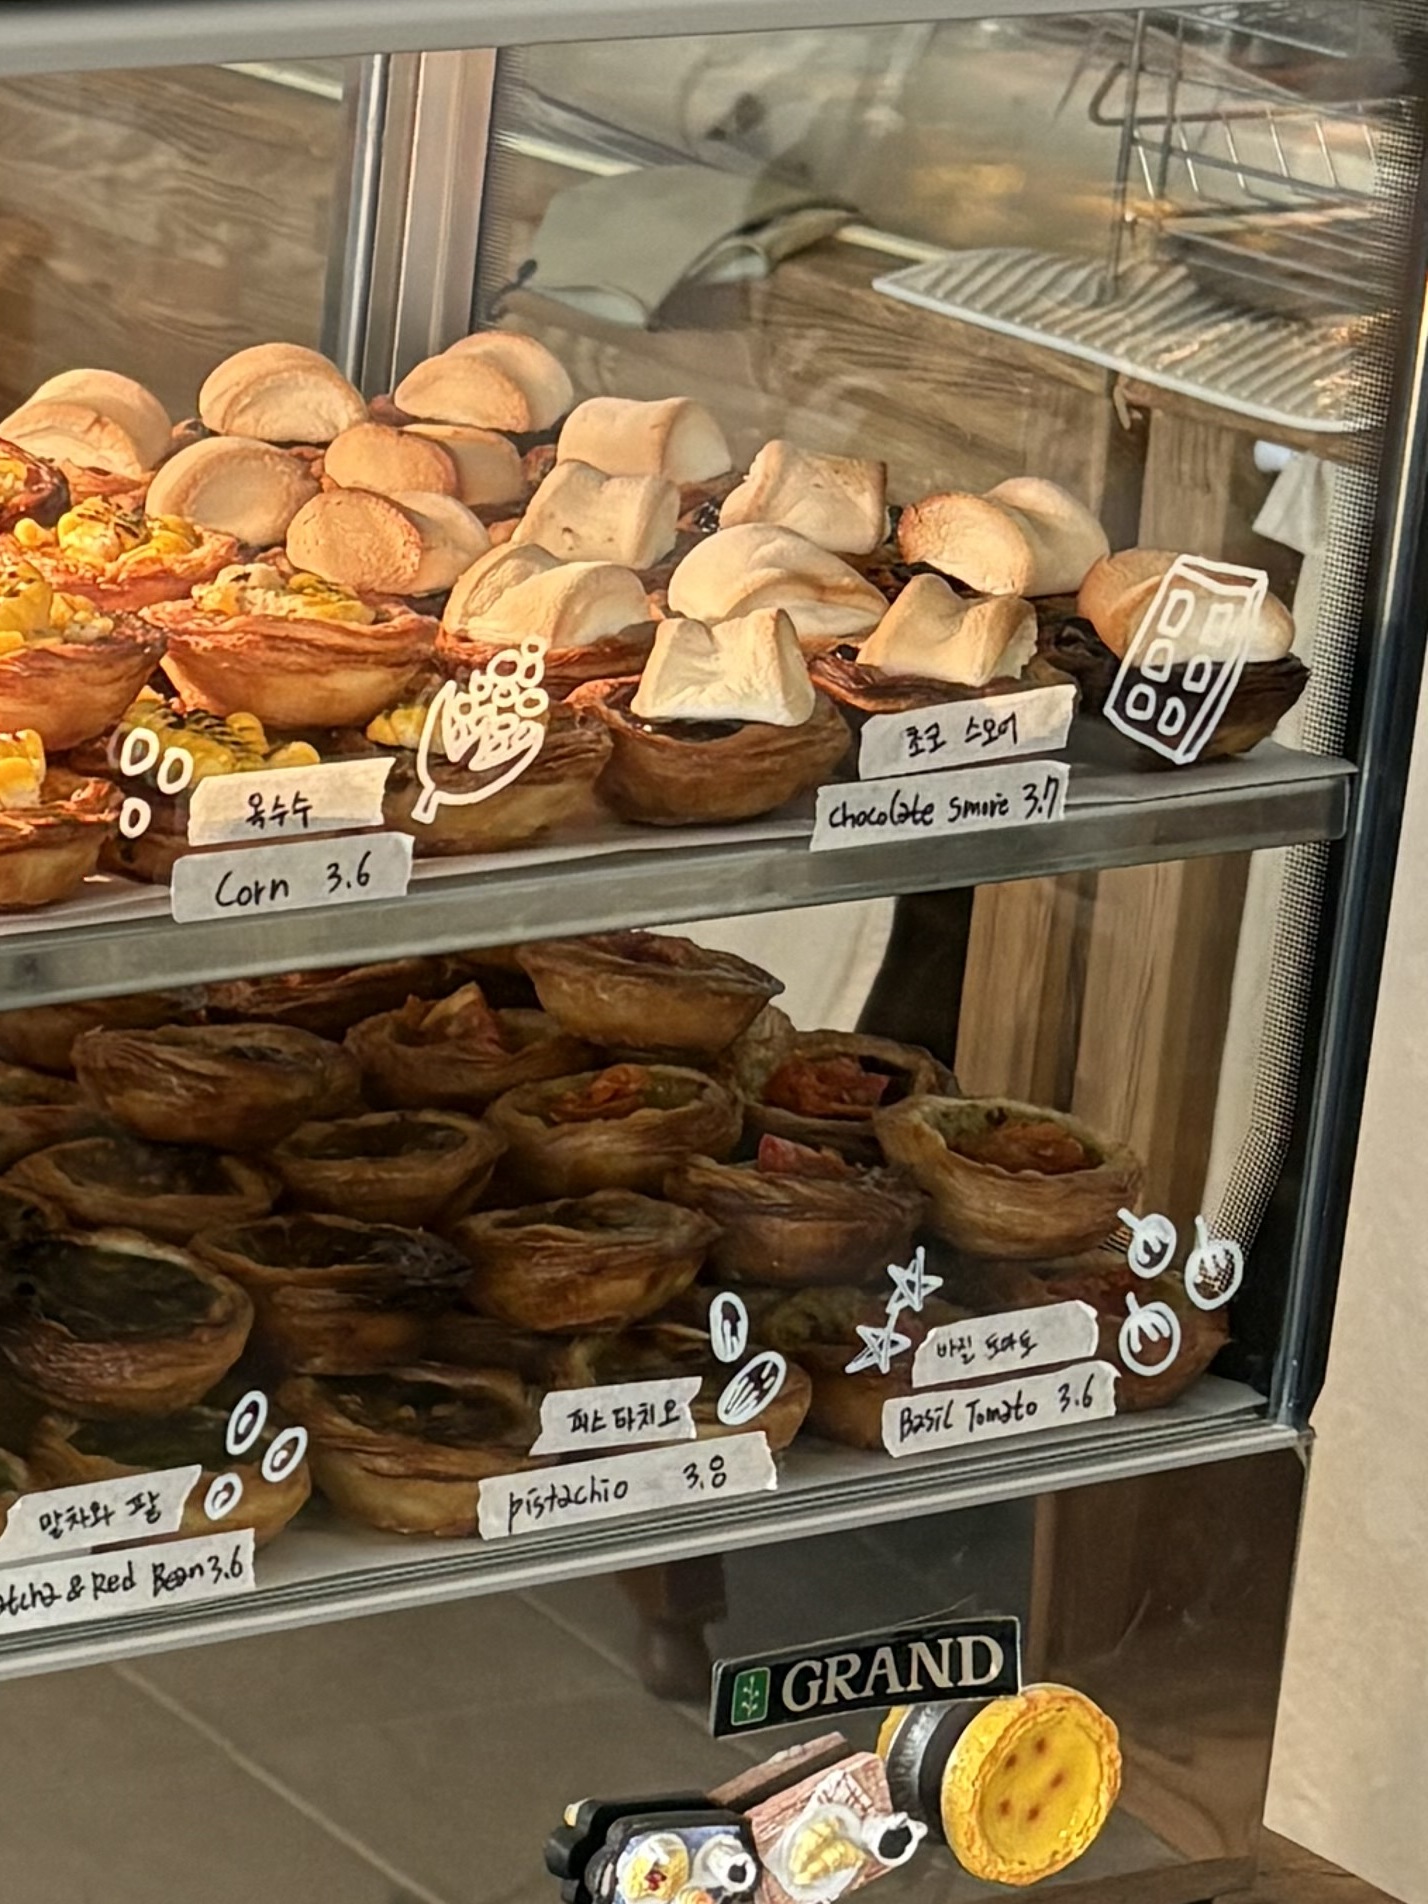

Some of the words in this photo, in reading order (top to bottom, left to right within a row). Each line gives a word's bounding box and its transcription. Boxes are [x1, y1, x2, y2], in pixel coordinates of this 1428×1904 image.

[905, 722, 947, 758] 초코
[246, 790, 313, 829] 옥수수
[1022, 775, 1060, 825] 3.7
[215, 871, 290, 907] Corn
[327, 850, 372, 893] 3.6
[936, 1334, 975, 1365] 바질
[985, 1329, 1037, 1361] 토마토
[566, 1399, 681, 1434] 피스타치오
[899, 1398, 954, 1443] Basil
[966, 1390, 1038, 1433] Tomato
[1058, 1373, 1095, 1413] 3.6
[682, 1454, 727, 1491] 3.8
[39, 1501, 115, 1540] 말차와
[66, 1575, 86, 1603] &
[91, 1560, 137, 1601] Red
[152, 1561, 205, 1598] Bean
[207, 1544, 244, 1585] 3.6
[781, 1634, 1004, 1713] GRAND
